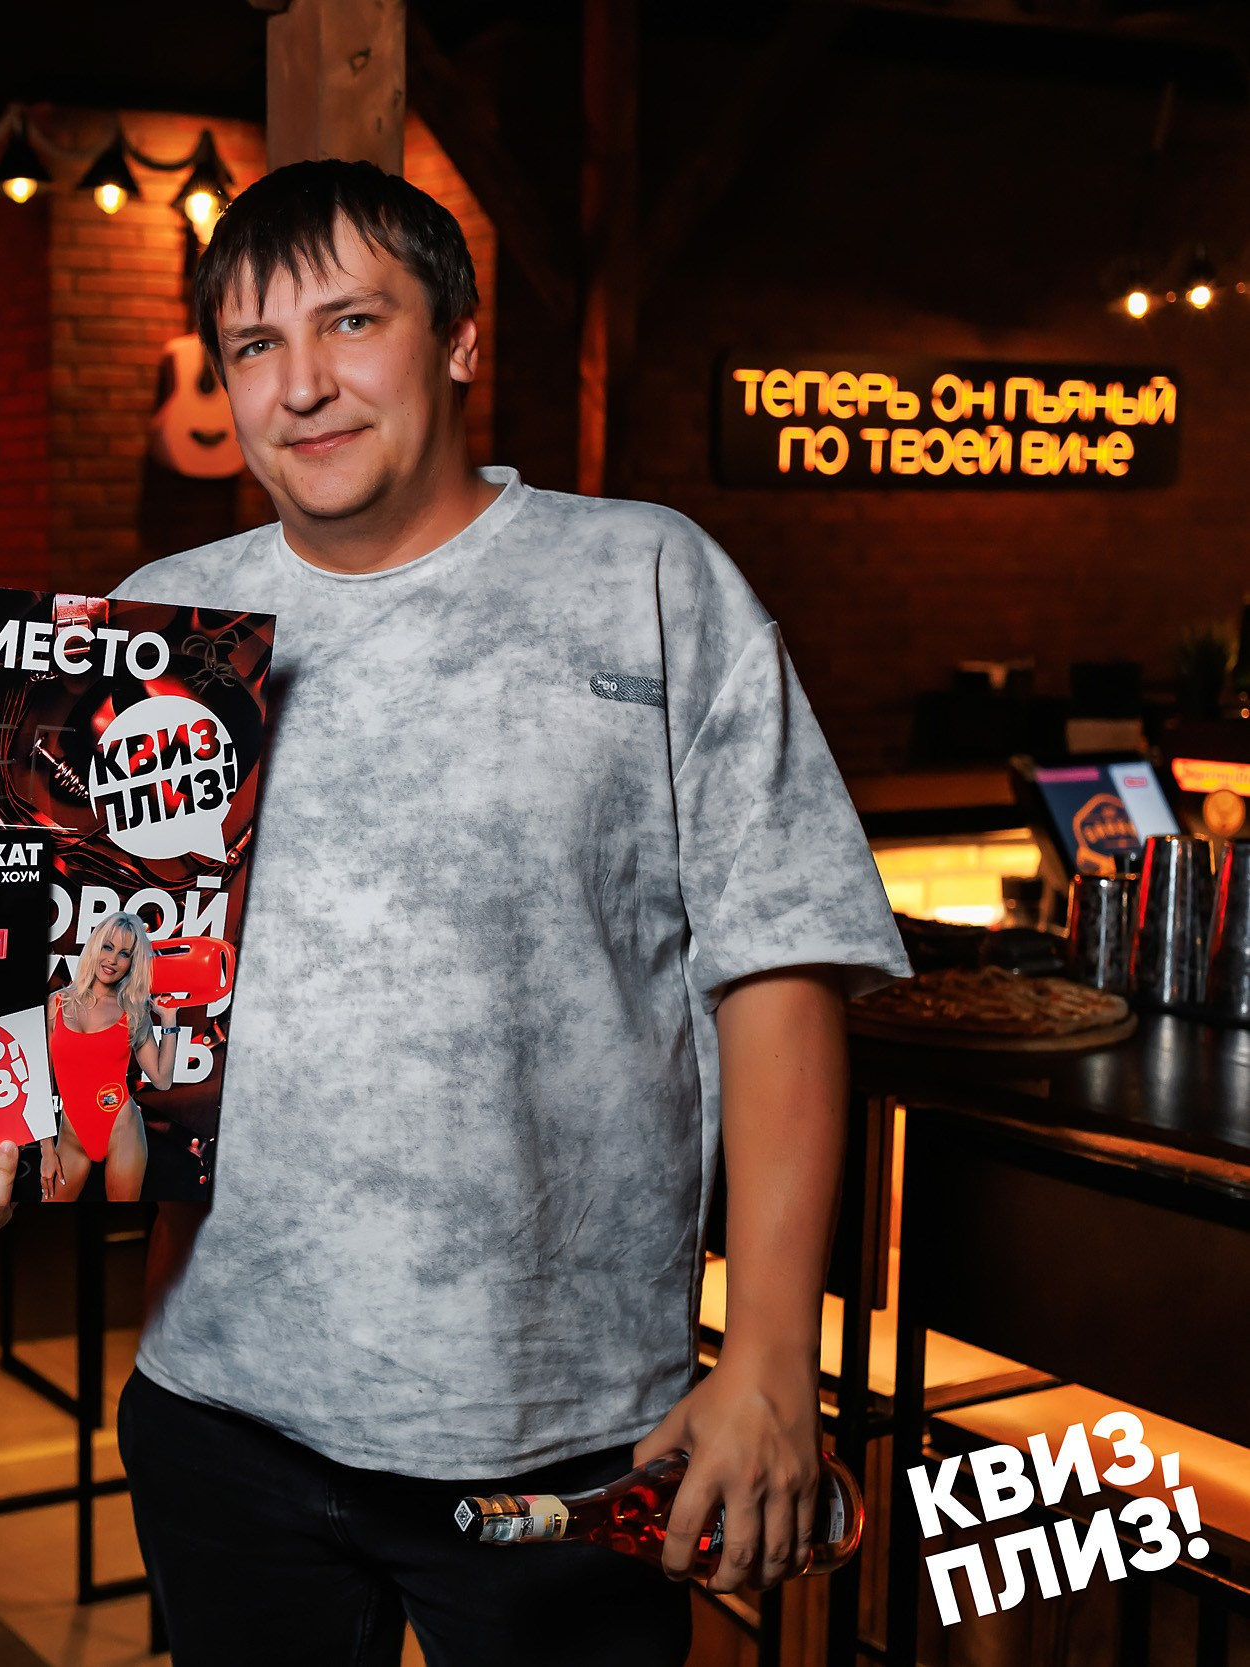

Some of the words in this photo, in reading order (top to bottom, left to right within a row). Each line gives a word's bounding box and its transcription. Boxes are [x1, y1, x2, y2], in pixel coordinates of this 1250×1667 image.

[931, 373, 995, 422] ОН
[778, 425, 849, 476] ПО
[94, 763, 237, 834] ПЛИЗ!
[1, 870, 40, 884] ХОУМ
